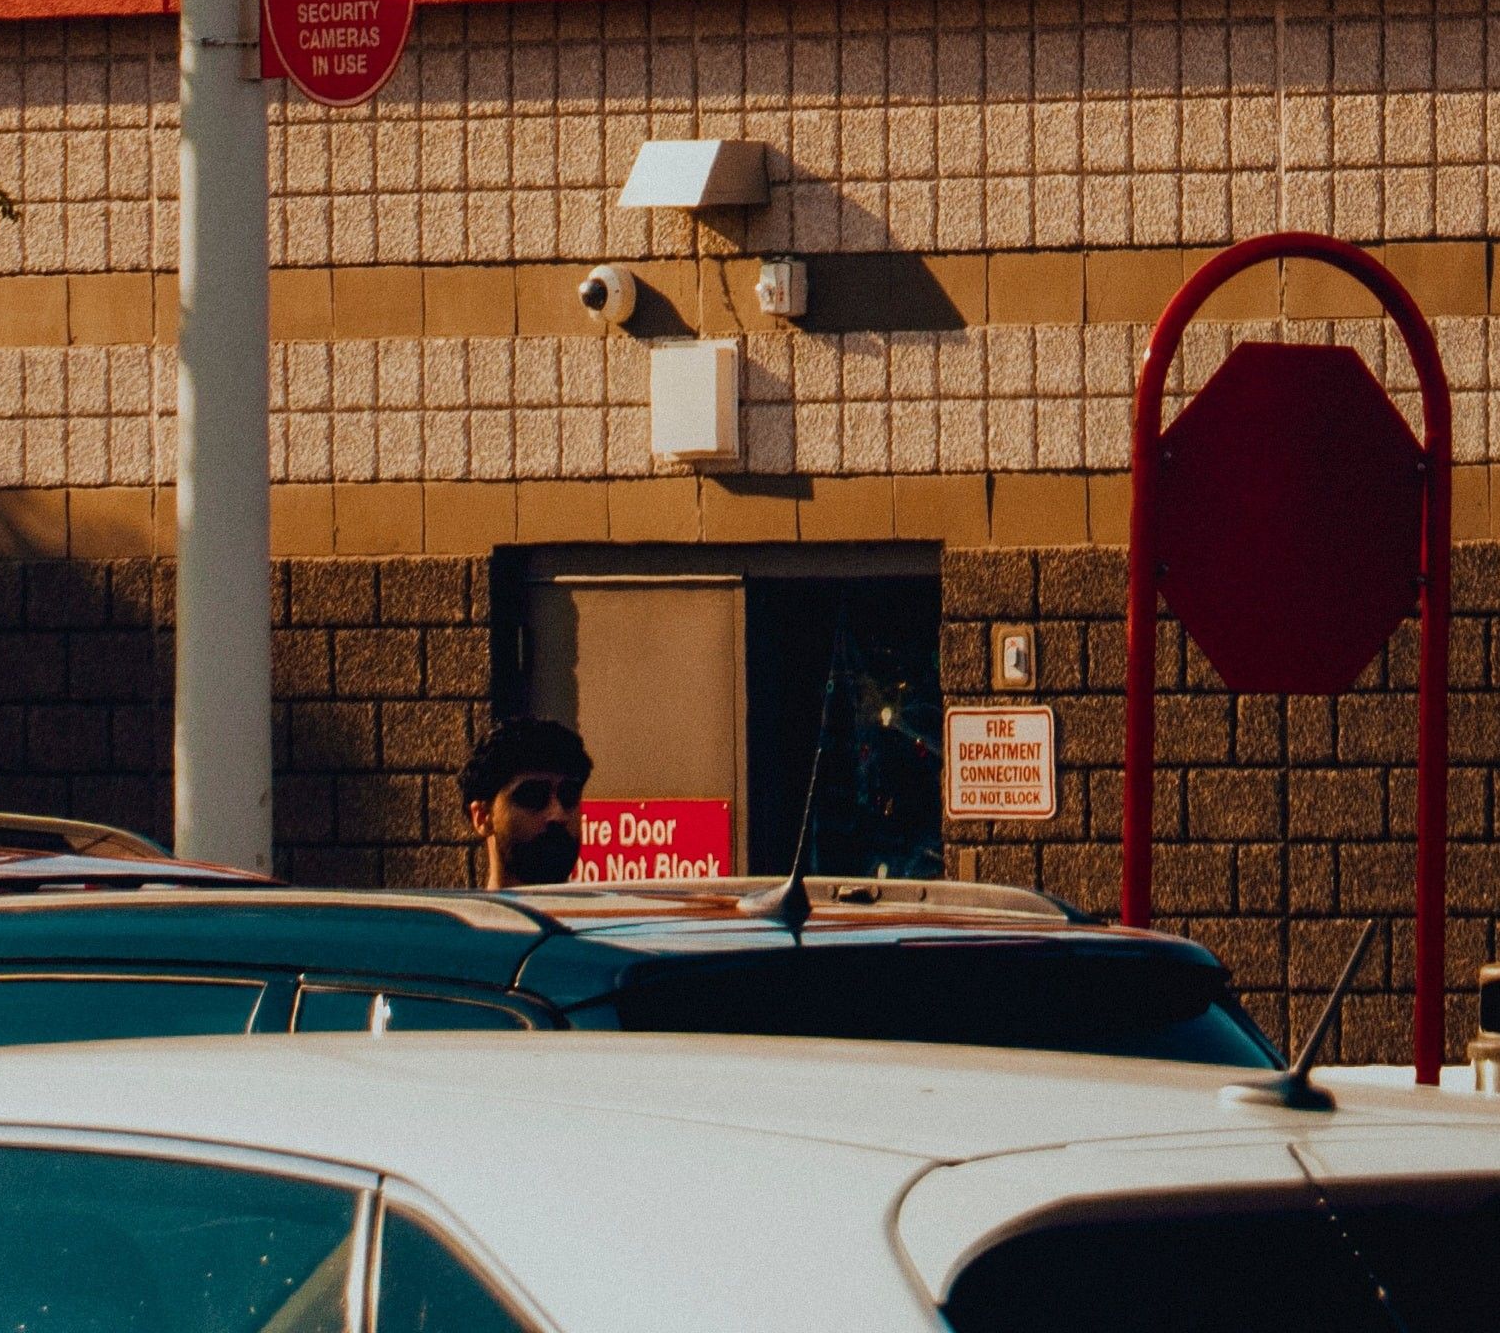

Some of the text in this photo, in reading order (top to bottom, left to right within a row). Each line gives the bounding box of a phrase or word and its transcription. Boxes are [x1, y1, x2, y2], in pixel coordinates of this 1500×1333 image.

[297, 0, 380, 23] SECURITY
[300, 26, 380, 50] CAMERAS
[312, 54, 368, 77] IN USE
[986, 719, 1015, 737] FIRE
[959, 742, 1042, 761] DEPARTMENT
[960, 765, 1041, 782] CONNECTION
[961, 791, 1041, 805] DO NOT BLOCK
[581, 812, 677, 847] ire Door
[606, 853, 647, 881] Not
[654, 852, 721, 879] Block
